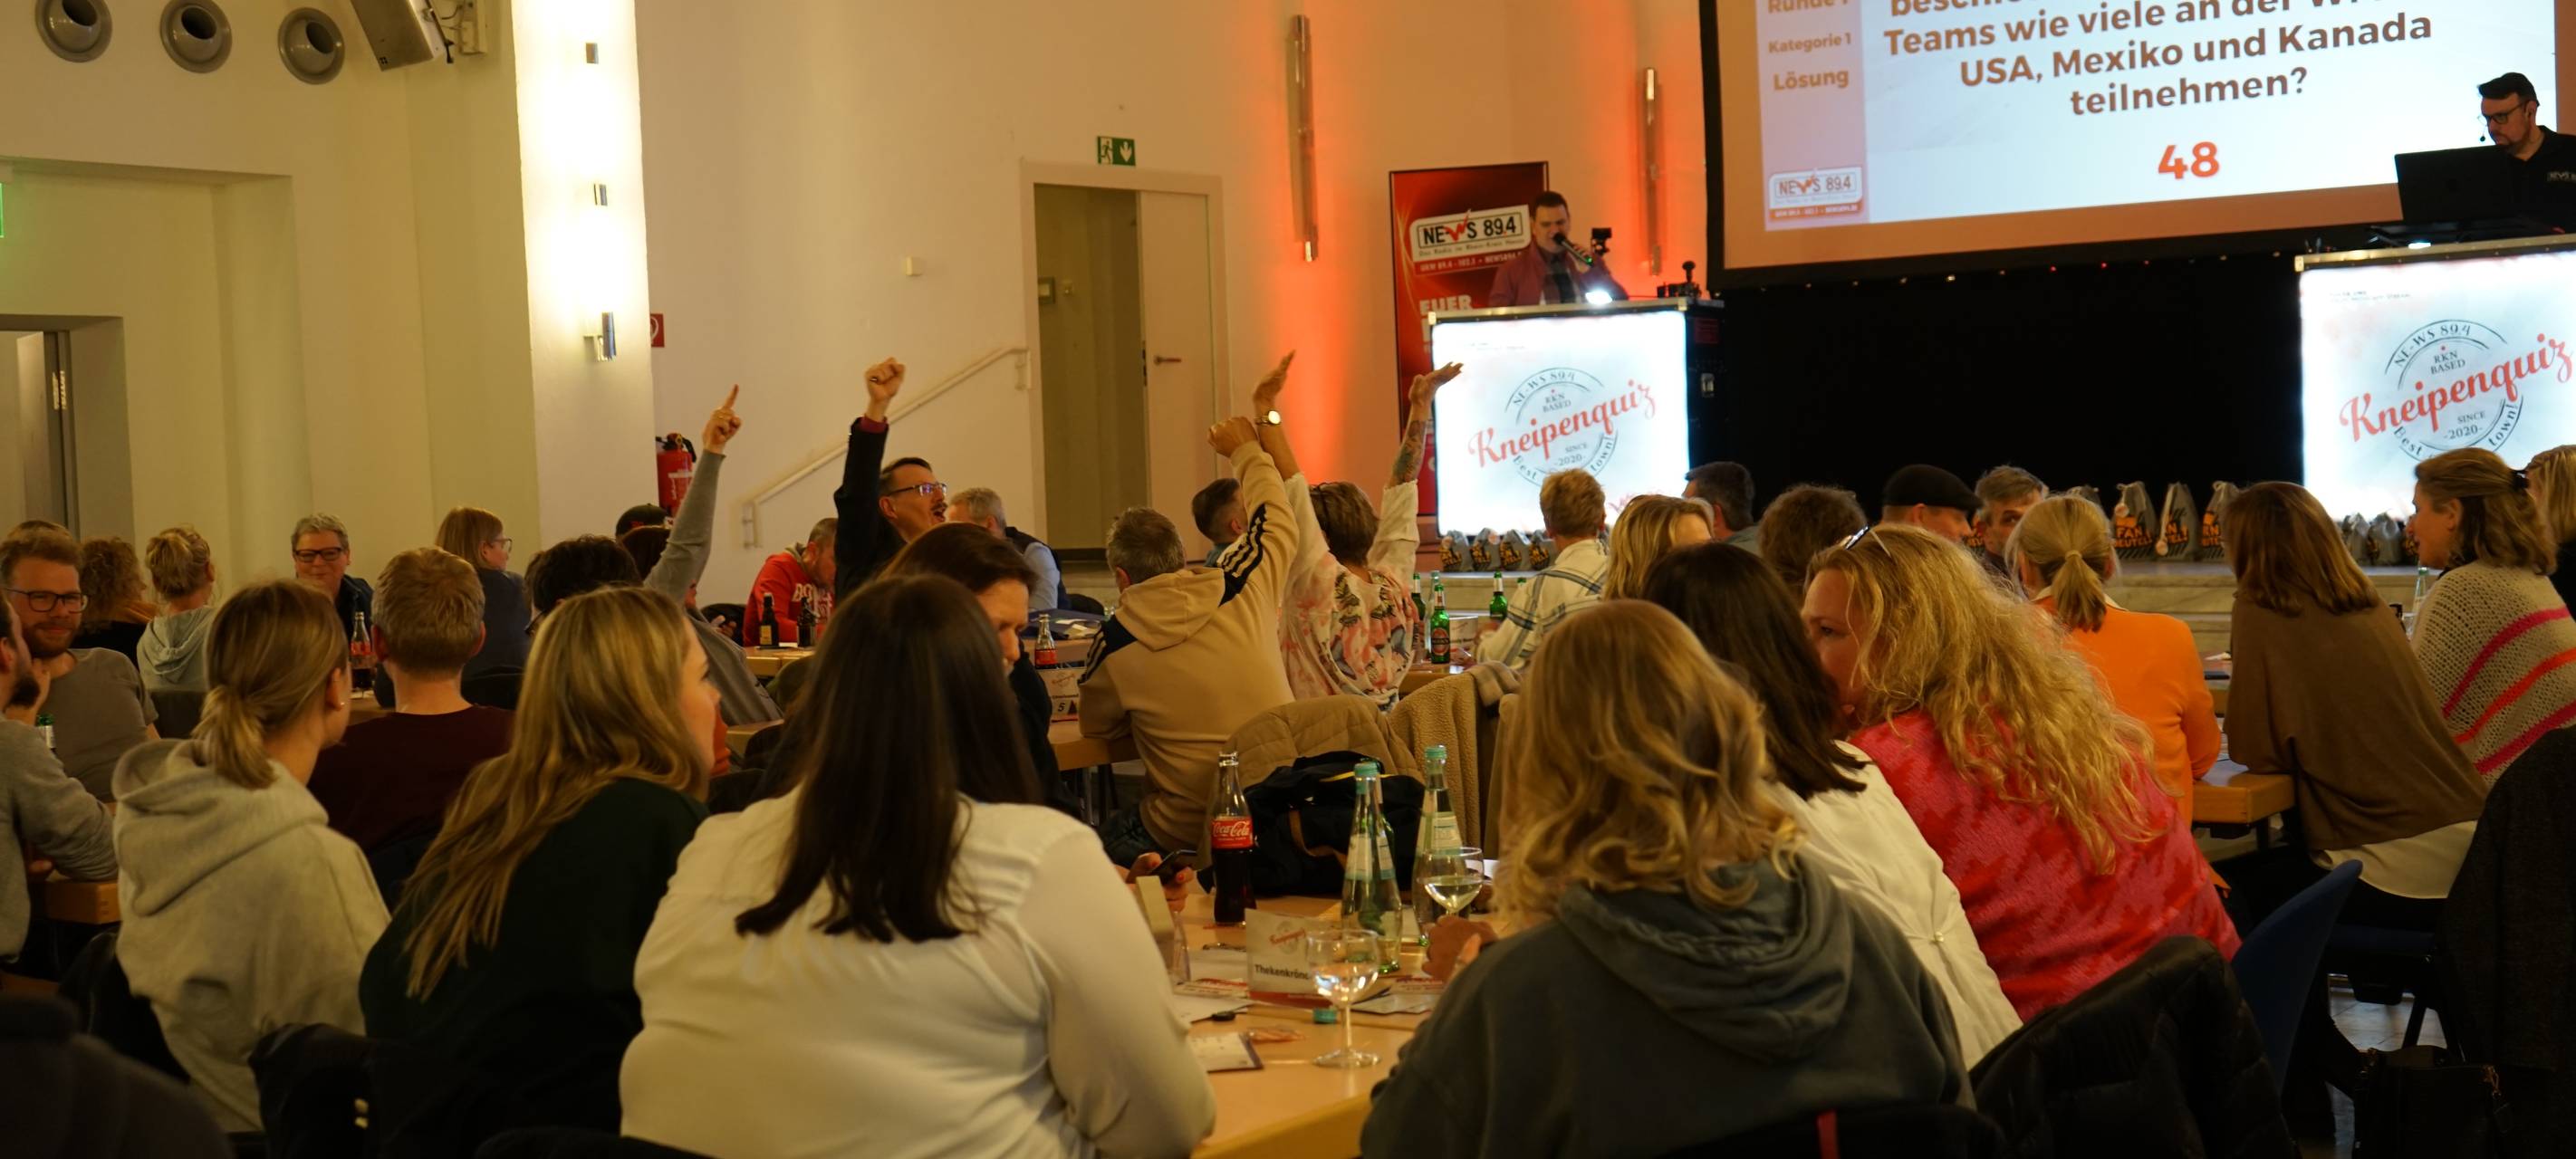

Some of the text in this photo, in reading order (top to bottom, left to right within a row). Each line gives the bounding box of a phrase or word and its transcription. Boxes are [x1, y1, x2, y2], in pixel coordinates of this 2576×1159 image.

[2176, 0, 2220, 23] an
[1884, 0, 2165, 55] Teams wie viele
[1768, 32, 1851, 53] Kategorie 1
[1960, 12, 2431, 86] USA, Mexiko und Kanada
[1773, 71, 1849, 91] Lösung
[2071, 67, 2307, 114] teilnehmen?
[2158, 141, 2220, 179] 48
[1484, 216, 1516, 237] 89.4
[1419, 294, 1472, 315] EUER
[2430, 359, 2465, 374] BASED
[2434, 350, 2458, 363] RKN
[2339, 333, 2573, 442] Kneipenquiz
[1543, 399, 1572, 413] BASED
[1467, 379, 1656, 467] Kneipenquiz
[2457, 411, 2486, 424] SINCE
[2394, 404, 2518, 455] Best town!
